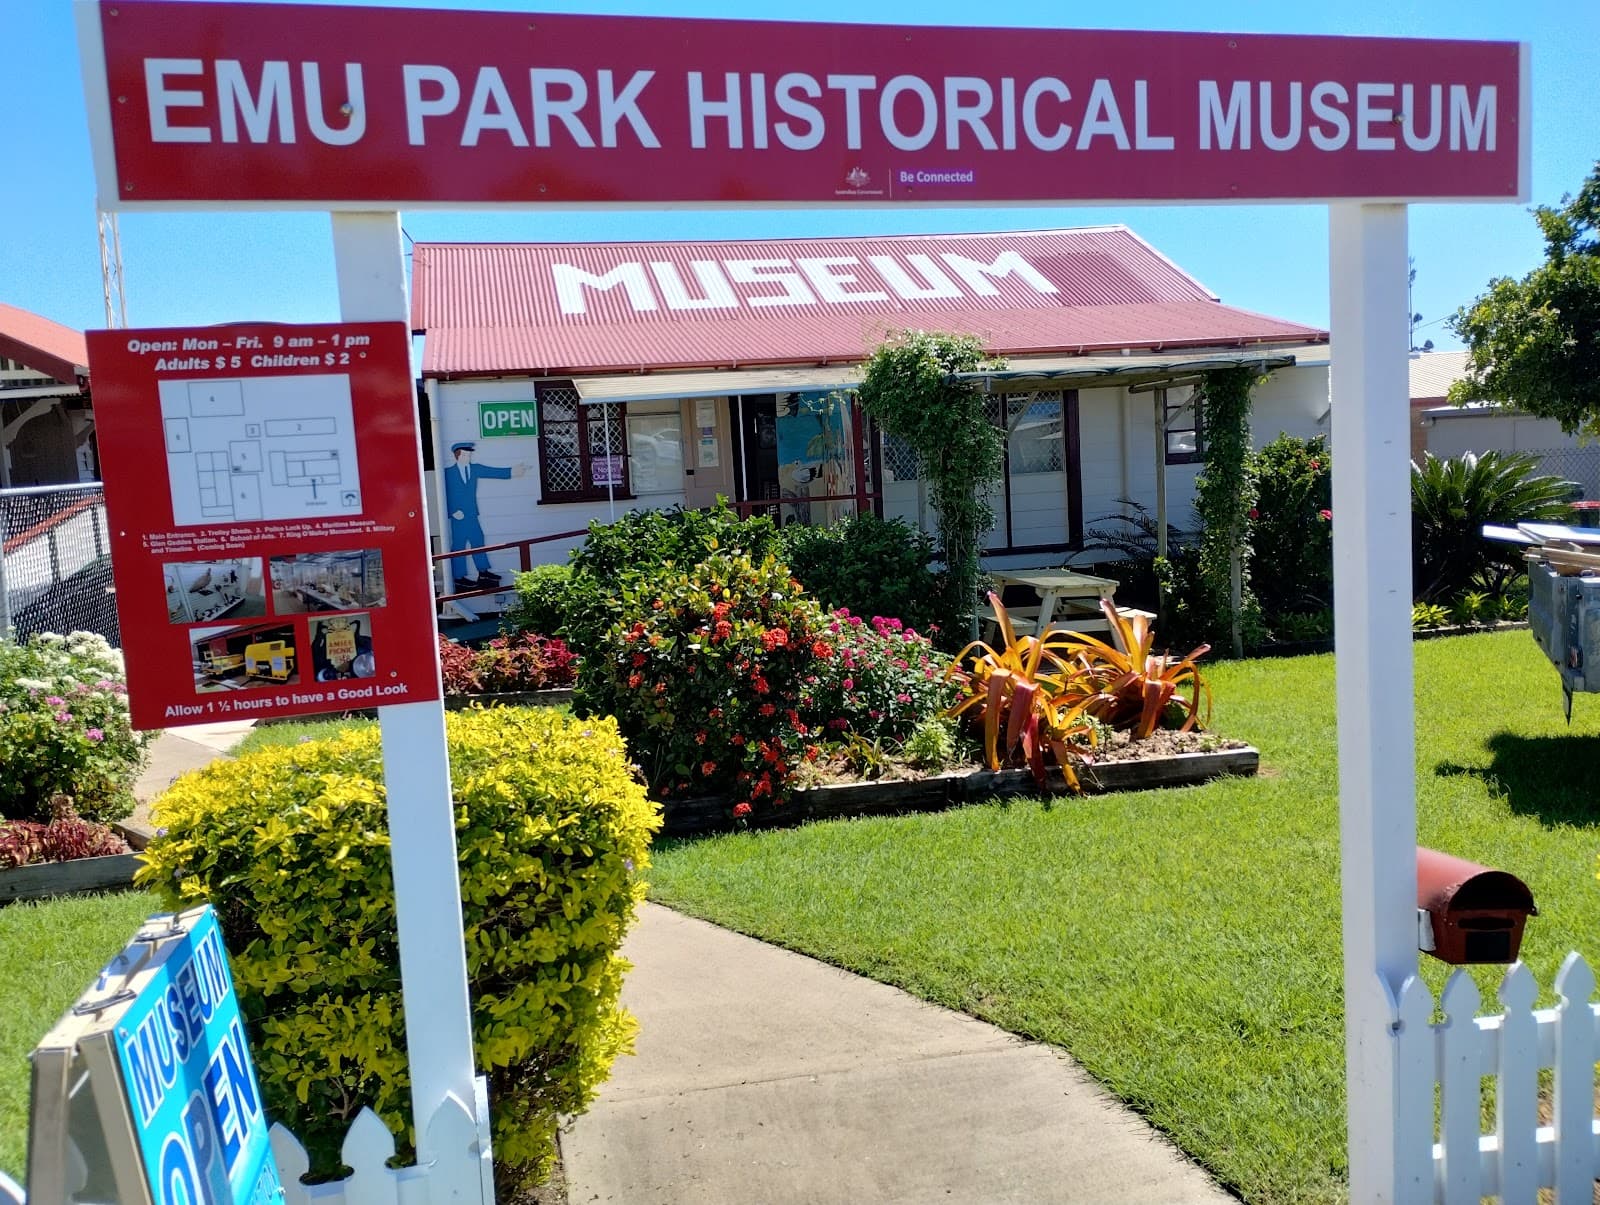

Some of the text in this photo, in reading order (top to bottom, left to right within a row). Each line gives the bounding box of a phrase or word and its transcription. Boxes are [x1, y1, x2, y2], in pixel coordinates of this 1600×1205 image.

[143, 58, 1498, 153] EMU PARK HISTORICAL MUSEUM
[900, 171, 974, 183] Be Connected
[551, 250, 1061, 315] MUSEUM
[127, 338, 177, 355] Open:
[182, 338, 218, 351] Mon
[236, 337, 263, 349] Fri.
[273, 336, 285, 348] 9
[288, 337, 313, 348] am
[332, 334, 340, 346] 1
[345, 335, 371, 349] pm
[155, 353, 349, 371] Adults $ 5 Children $ 2
[483, 410, 534, 429] OPEN
[165, 683, 408, 718] Allow 1 ½ hours to have a Good Look
[124, 927, 230, 1130] MUSEUM
